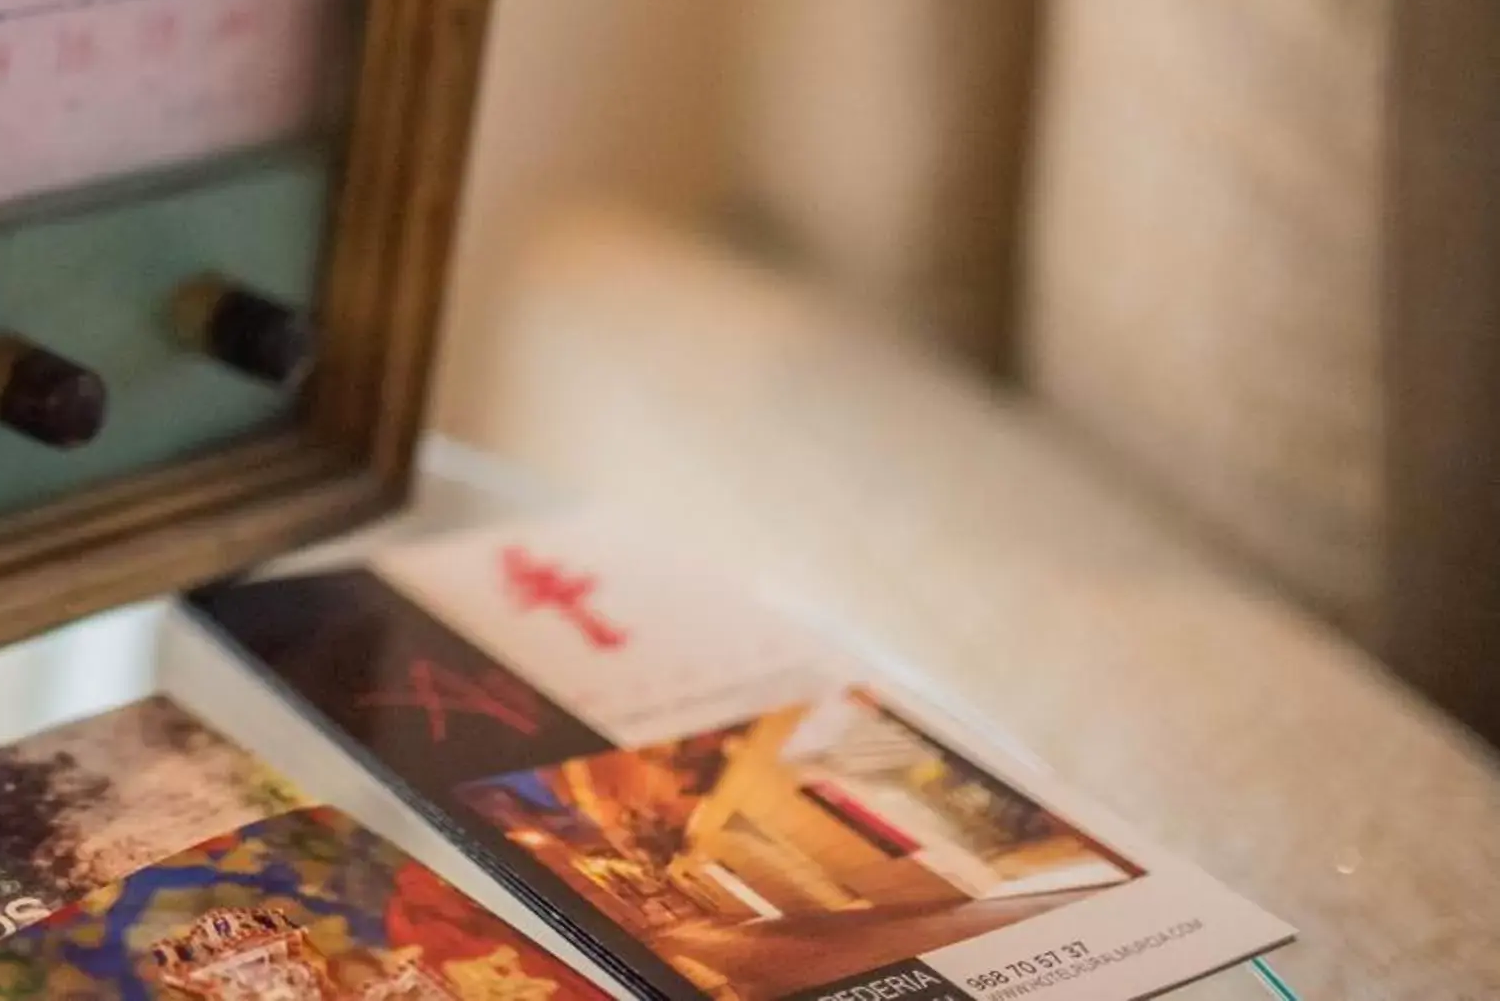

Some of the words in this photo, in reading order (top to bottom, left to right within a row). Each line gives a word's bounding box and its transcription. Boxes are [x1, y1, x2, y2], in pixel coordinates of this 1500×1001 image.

[965, 969, 1011, 993] 968
[1008, 960, 1036, 984] 70
[1037, 950, 1063, 974] 57
[1061, 940, 1091, 964] 37
